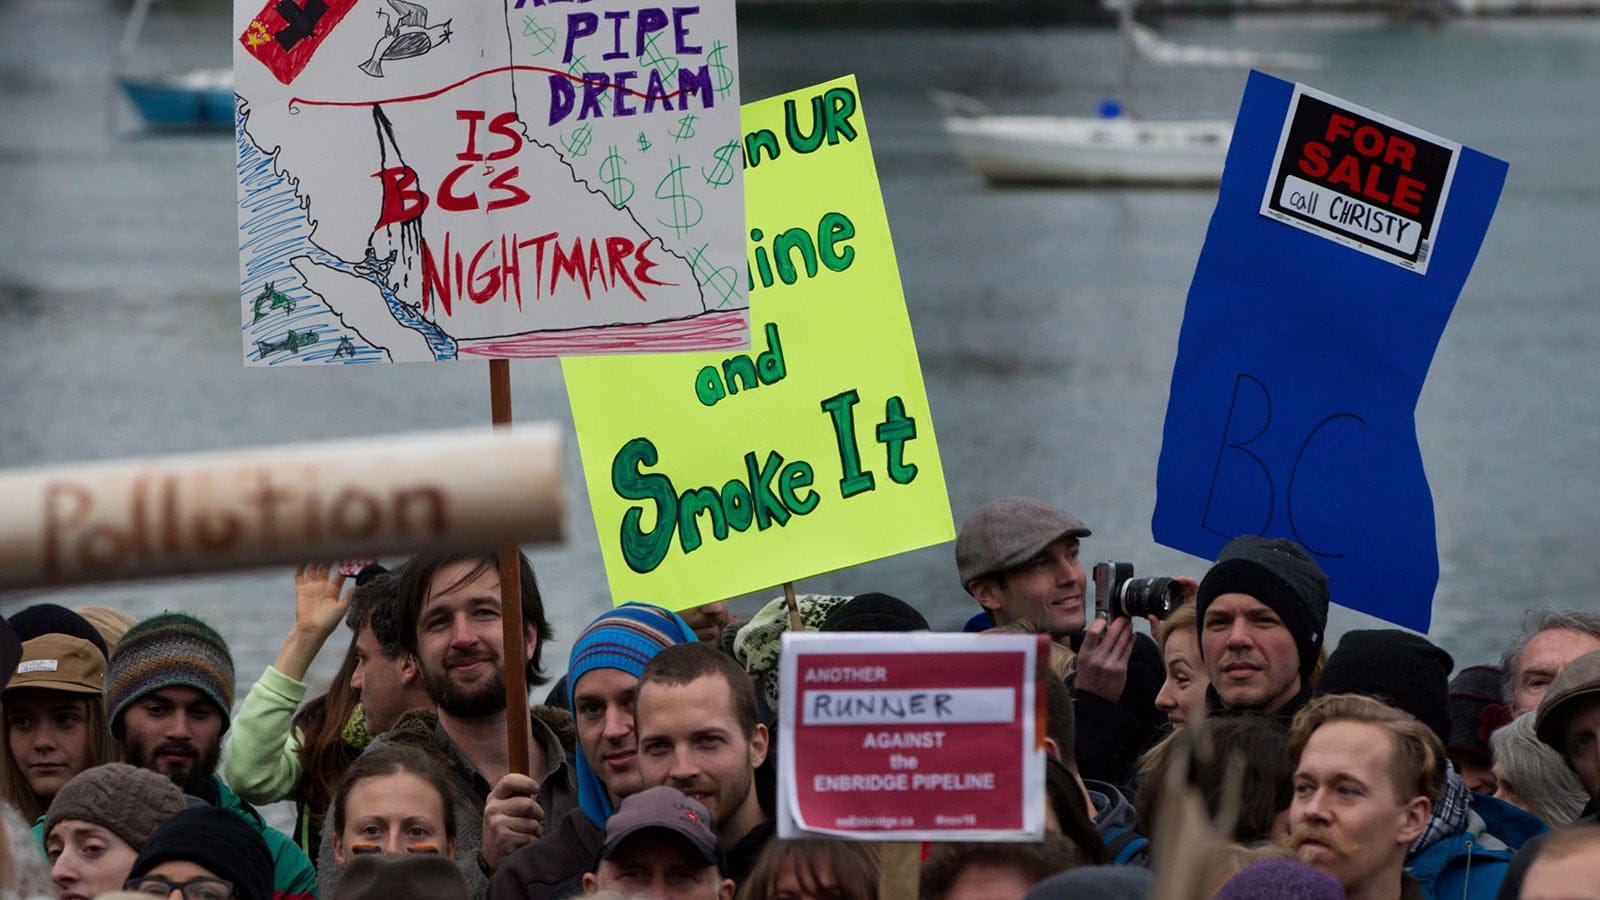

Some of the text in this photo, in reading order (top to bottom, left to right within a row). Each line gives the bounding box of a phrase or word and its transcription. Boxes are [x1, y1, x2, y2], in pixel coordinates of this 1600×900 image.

[562, 6, 703, 64] PIPE
[548, 64, 715, 127] DREAM
[784, 87, 858, 154] UR
[456, 110, 523, 162] IS
[1324, 113, 1417, 172] FOR
[1298, 141, 1427, 215] SALE
[1289, 190, 1319, 215] call
[1329, 196, 1411, 243] CHRISTY
[420, 230, 680, 318] NIGHTMARE
[695, 322, 786, 407] and
[611, 388, 919, 574] Smoke It
[1202, 373, 1366, 559] BC
[42, 470, 447, 578] Pollution
[804, 666, 888, 684] ANOTHER
[812, 693, 954, 720] RUNNER
[863, 731, 946, 749] AGAINST
[889, 754, 918, 770] the
[813, 772, 996, 793] ENBRIDGE PIPELINE
